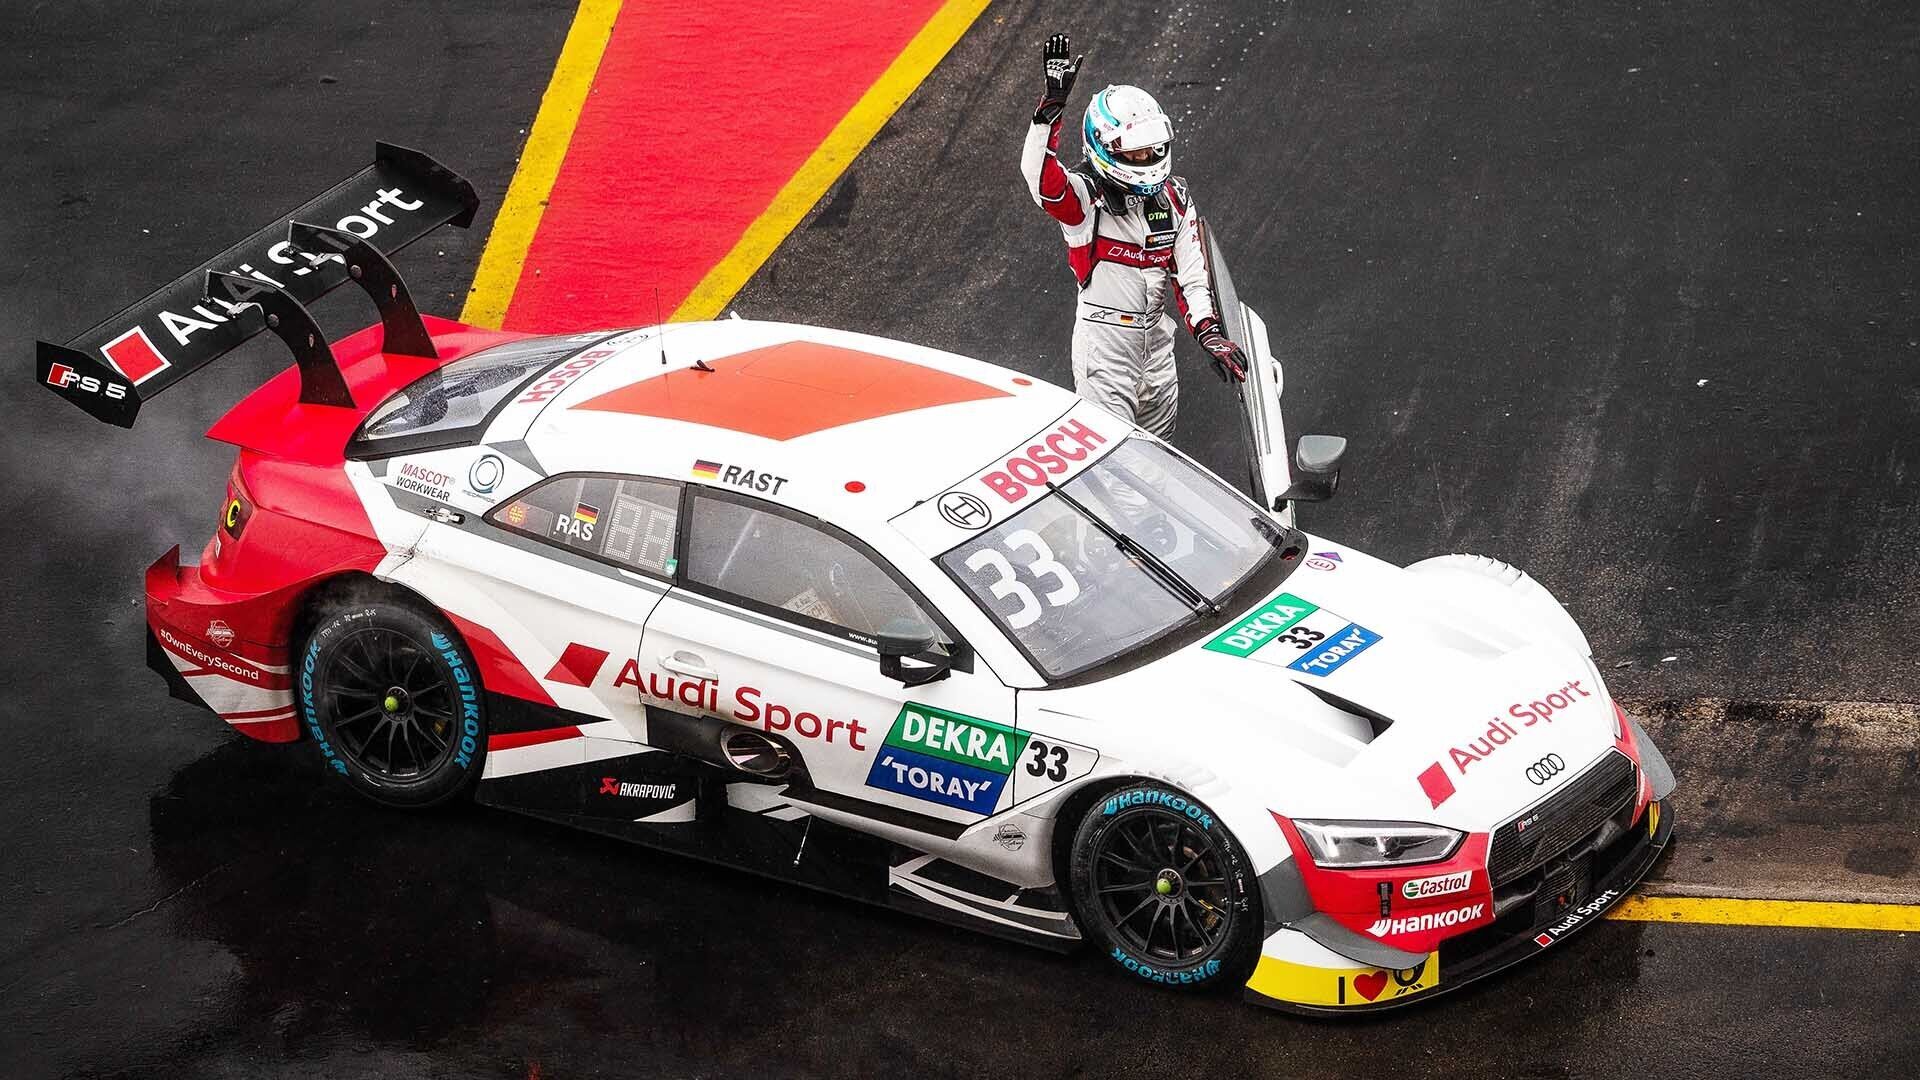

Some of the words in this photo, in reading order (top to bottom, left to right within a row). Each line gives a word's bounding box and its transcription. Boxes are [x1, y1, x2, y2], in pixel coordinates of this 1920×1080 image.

[1148, 211, 1168, 221] DTM
[60, 370, 102, 393] RS
[105, 382, 127, 400] 5
[518, 350, 616, 404] BOSCH
[723, 464, 788, 496] RAST
[980, 418, 1109, 504] BOSCH
[396, 475, 451, 502] WORKWEAR
[964, 528, 1081, 631] 33
[1222, 604, 1306, 650] DEKRA
[1277, 626, 1326, 650] 33
[160, 628, 259, 680] #OwnEverySecond
[613, 658, 718, 710] Audi
[733, 687, 868, 752] Sport
[901, 709, 1010, 768] DEKRA
[1449, 716, 1518, 775] Audi
[1508, 680, 1591, 727] Sport
[1025, 740, 1070, 783] 33
[619, 782, 676, 799] AKRAPOVIČ
[1420, 874, 1468, 896] Castrol
[1549, 913, 1584, 936] Audi
[1577, 889, 1619, 915] Sport
[1337, 976, 1346, 1005] I
